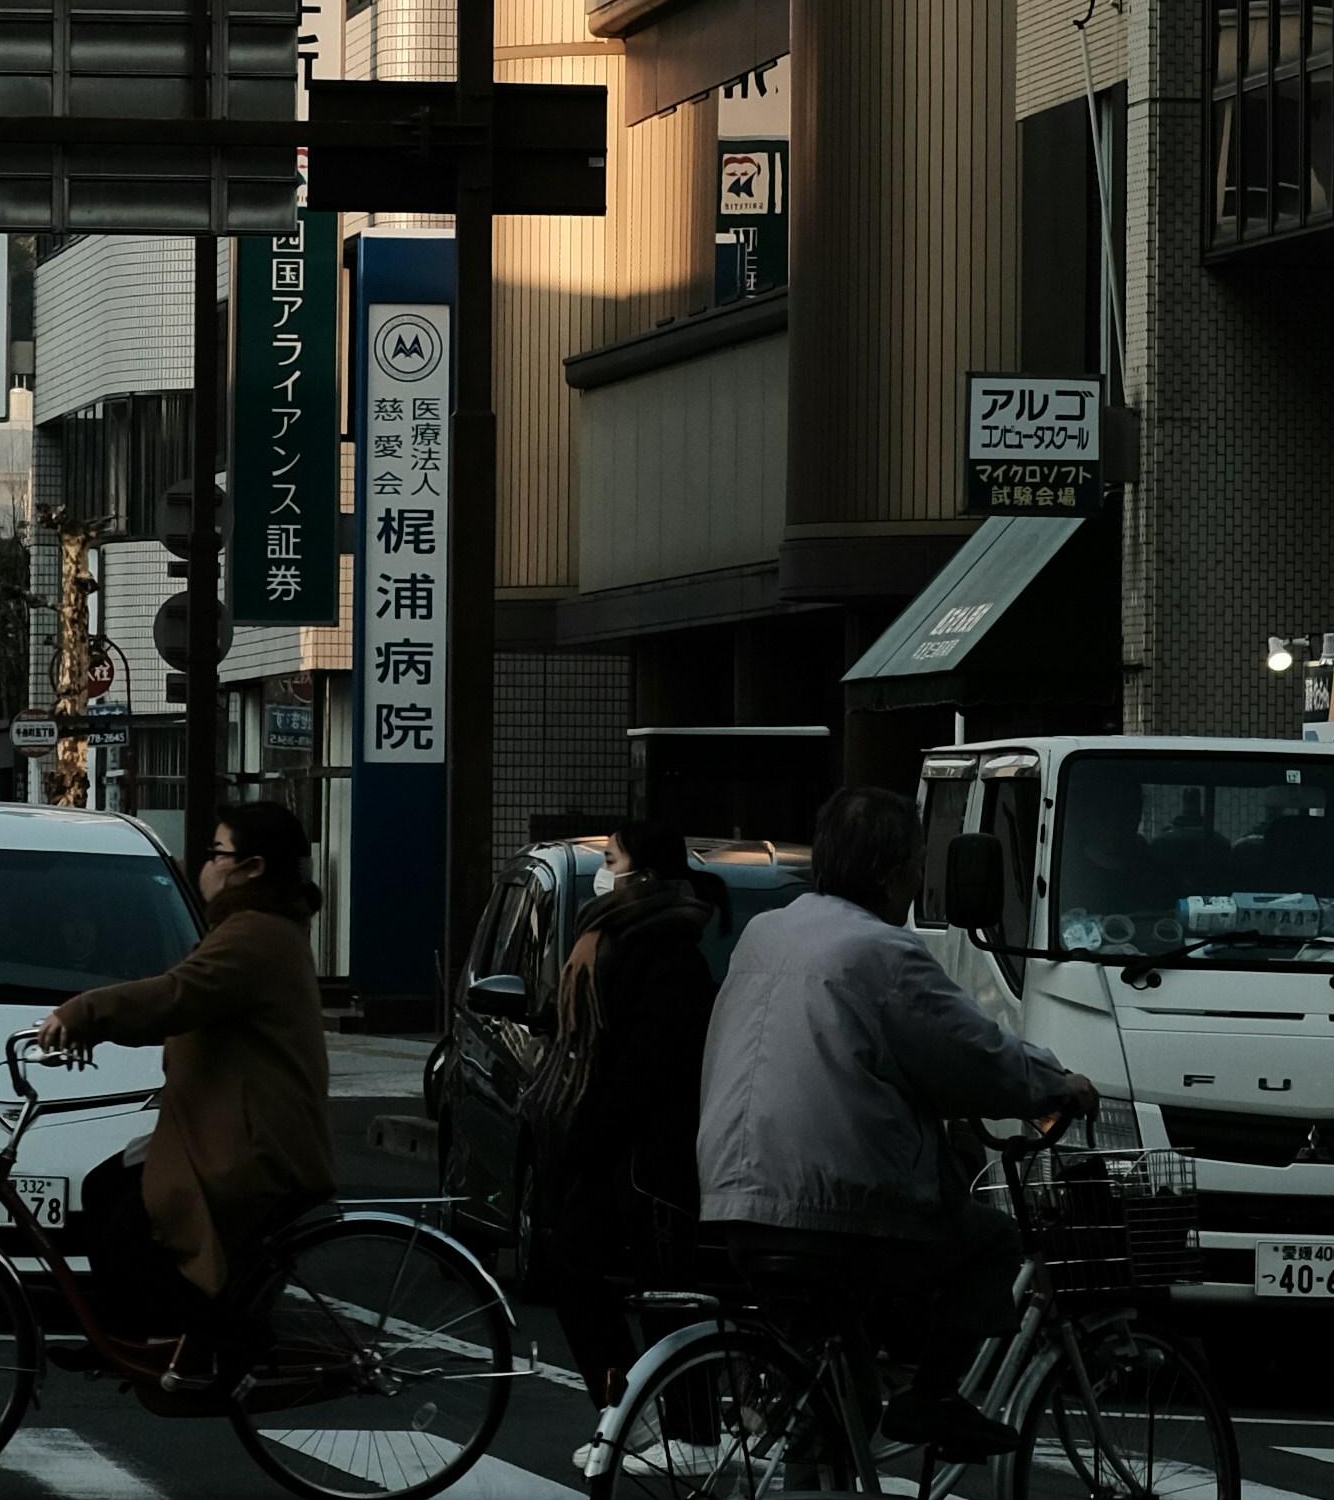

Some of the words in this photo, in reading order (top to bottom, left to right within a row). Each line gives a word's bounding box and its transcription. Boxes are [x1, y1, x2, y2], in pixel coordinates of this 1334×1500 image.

[981, 389, 1091, 422] アルゴ
[373, 397, 405, 496] 慈愛会
[411, 397, 441, 497] 医療法人
[981, 424, 1089, 451] コンピュータスクール
[975, 463, 1092, 485] マイクロソフト
[991, 485, 1077, 507] 試験会場
[374, 507, 436, 752] 梶浦病院
[87, 733, 126, 744] 78-2645
